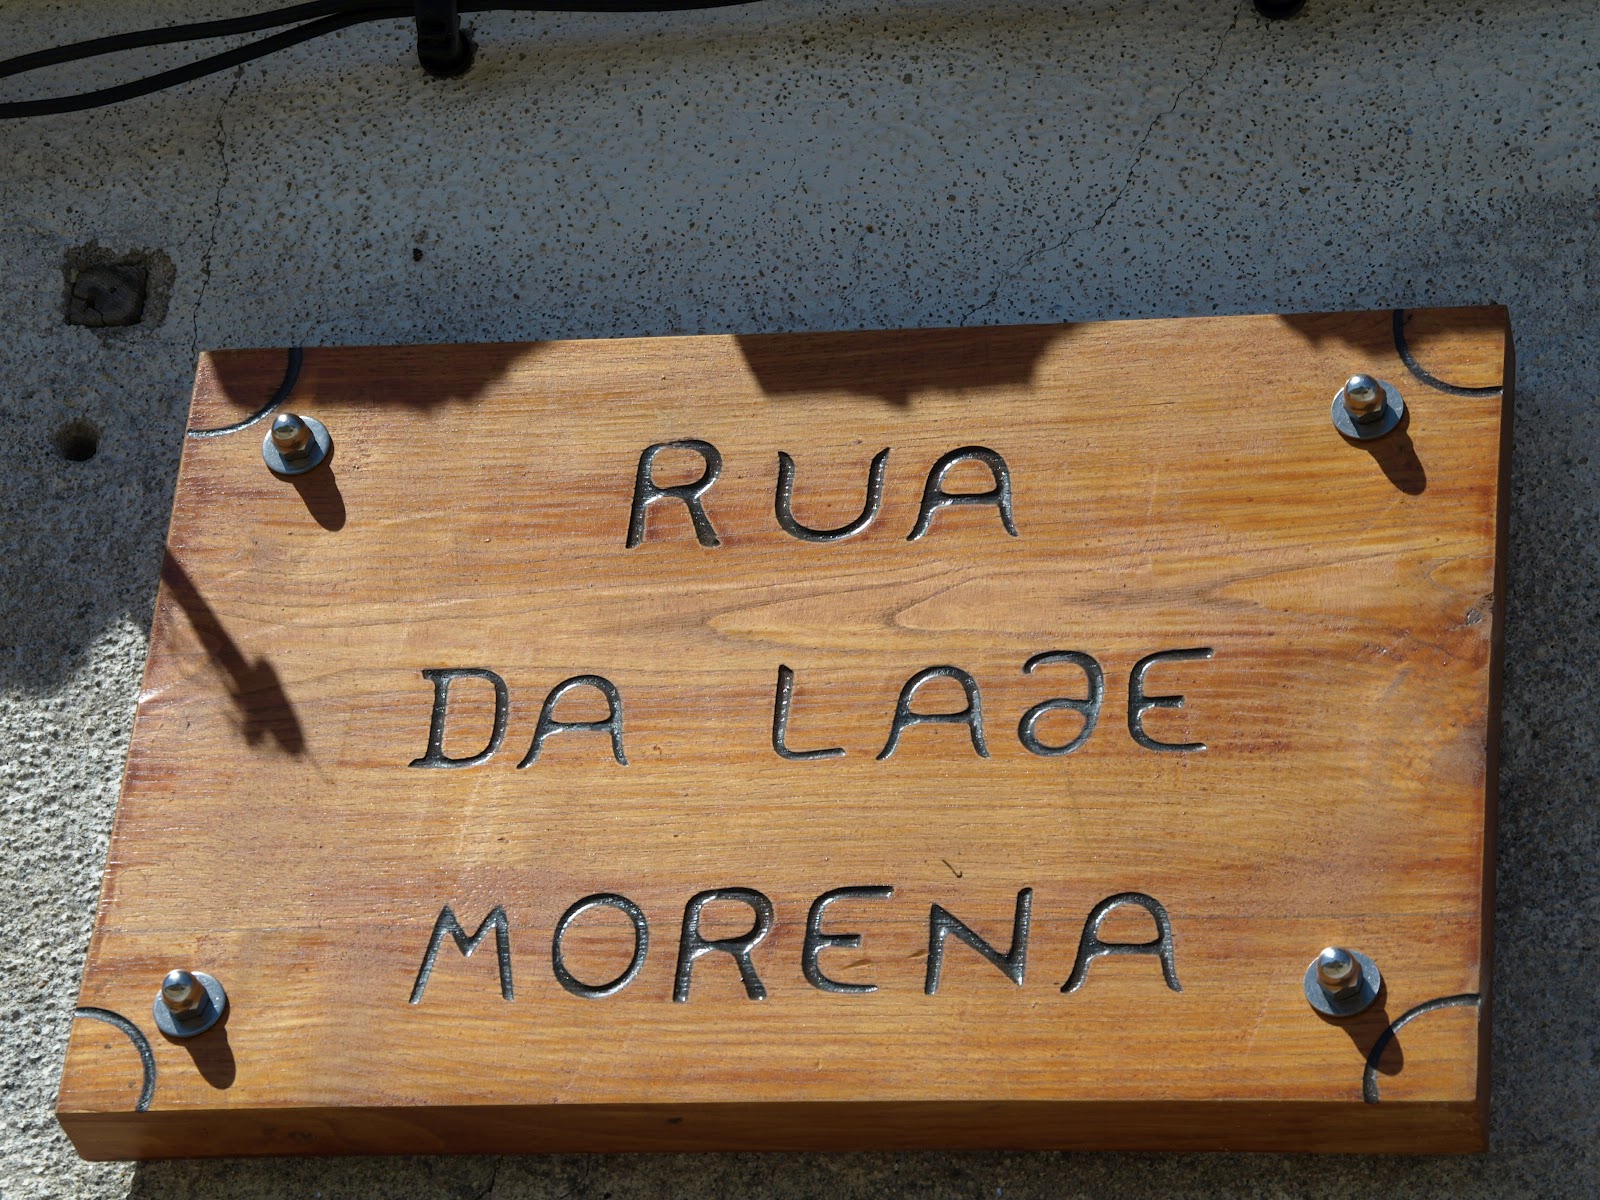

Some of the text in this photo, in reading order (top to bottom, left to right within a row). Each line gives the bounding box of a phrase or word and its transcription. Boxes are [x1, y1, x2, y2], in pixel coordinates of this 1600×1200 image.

[626, 439, 1018, 549] RUA
[408, 667, 629, 769] DA
[409, 885, 1182, 1004] MORENA
